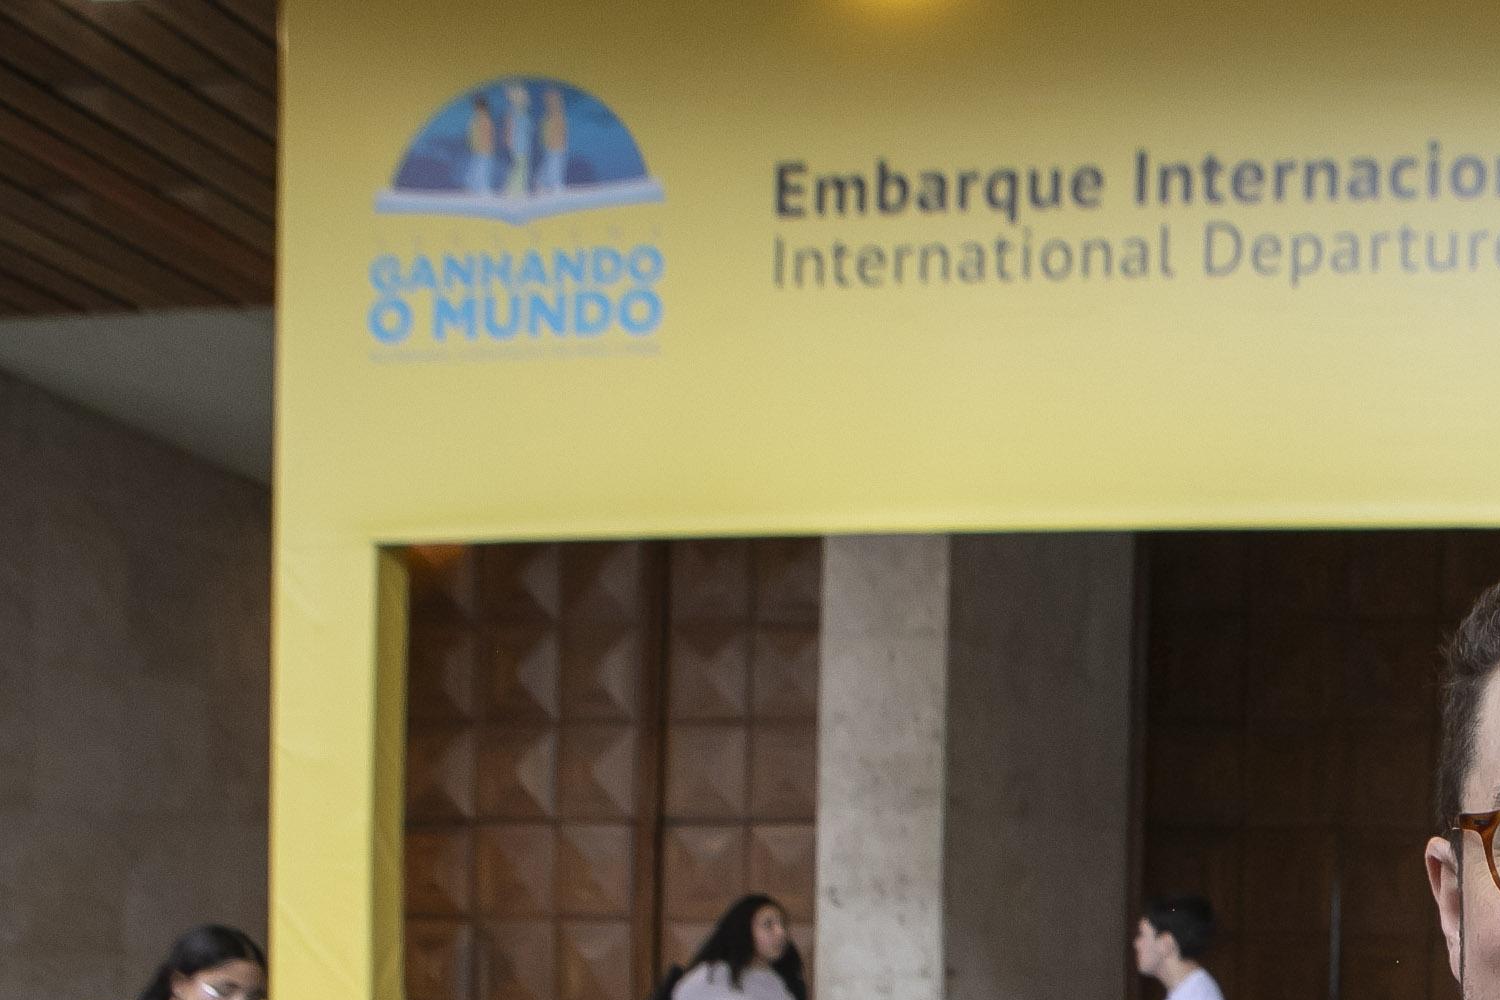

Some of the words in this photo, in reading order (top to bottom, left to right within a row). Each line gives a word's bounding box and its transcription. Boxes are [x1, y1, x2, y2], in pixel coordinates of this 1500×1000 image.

[775, 155, 1104, 223] Embarque
[368, 244, 664, 295] GANHANDO
[774, 224, 1175, 288] International
[367, 299, 413, 343] O
[431, 289, 663, 341] MUNDO
